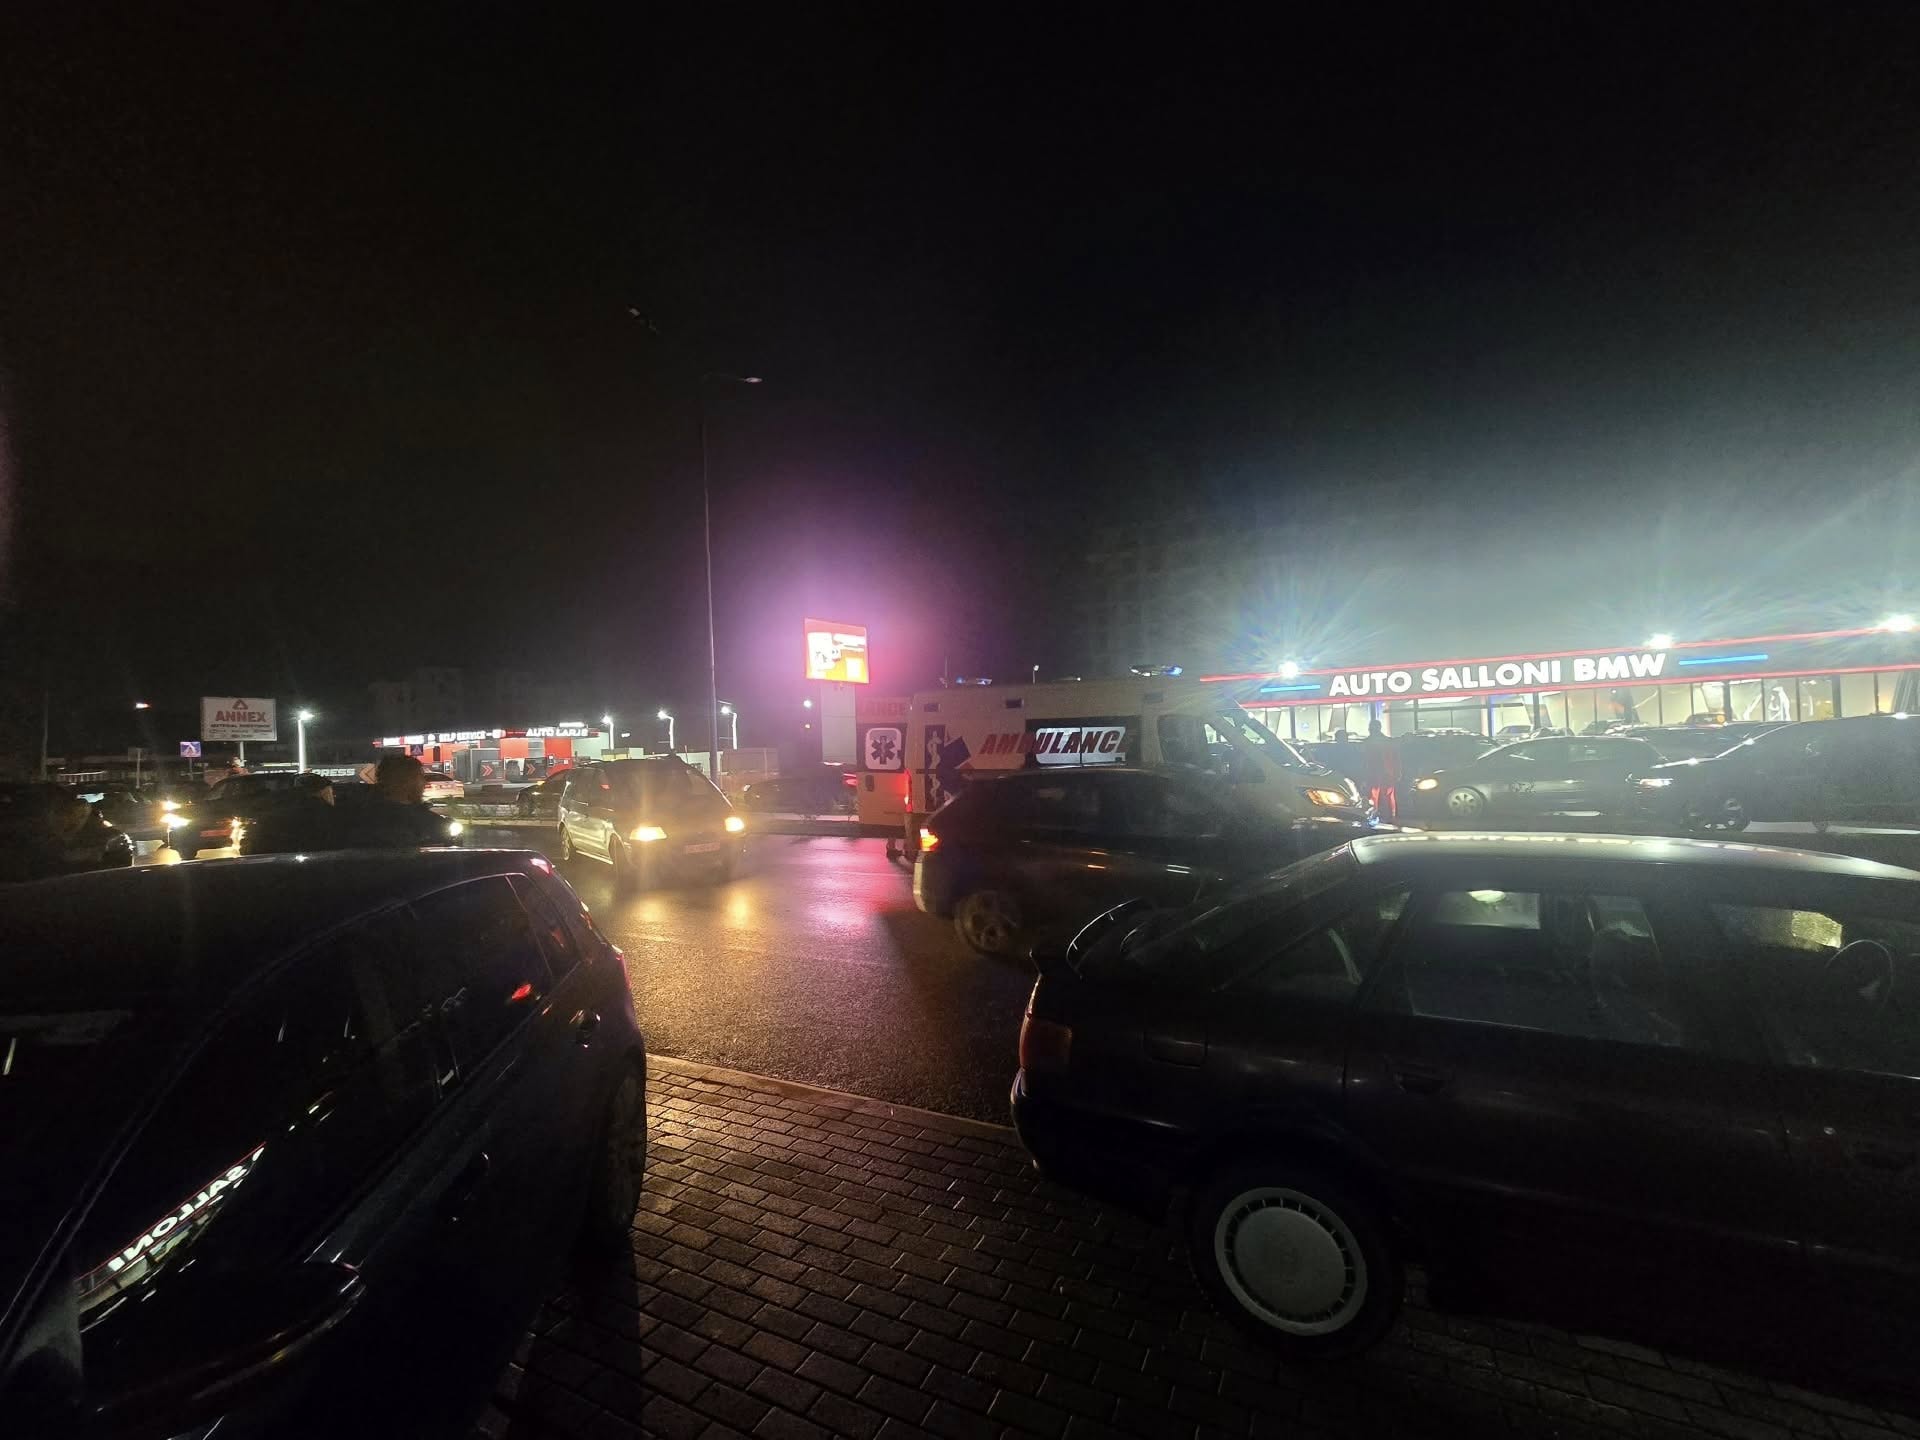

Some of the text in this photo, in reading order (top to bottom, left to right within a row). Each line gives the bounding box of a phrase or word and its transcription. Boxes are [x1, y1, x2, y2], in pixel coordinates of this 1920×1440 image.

[1329, 652, 1667, 698] AUTO SALLONI BMW
[215, 710, 267, 722] ANNEX
[525, 727, 554, 737] AUTO
